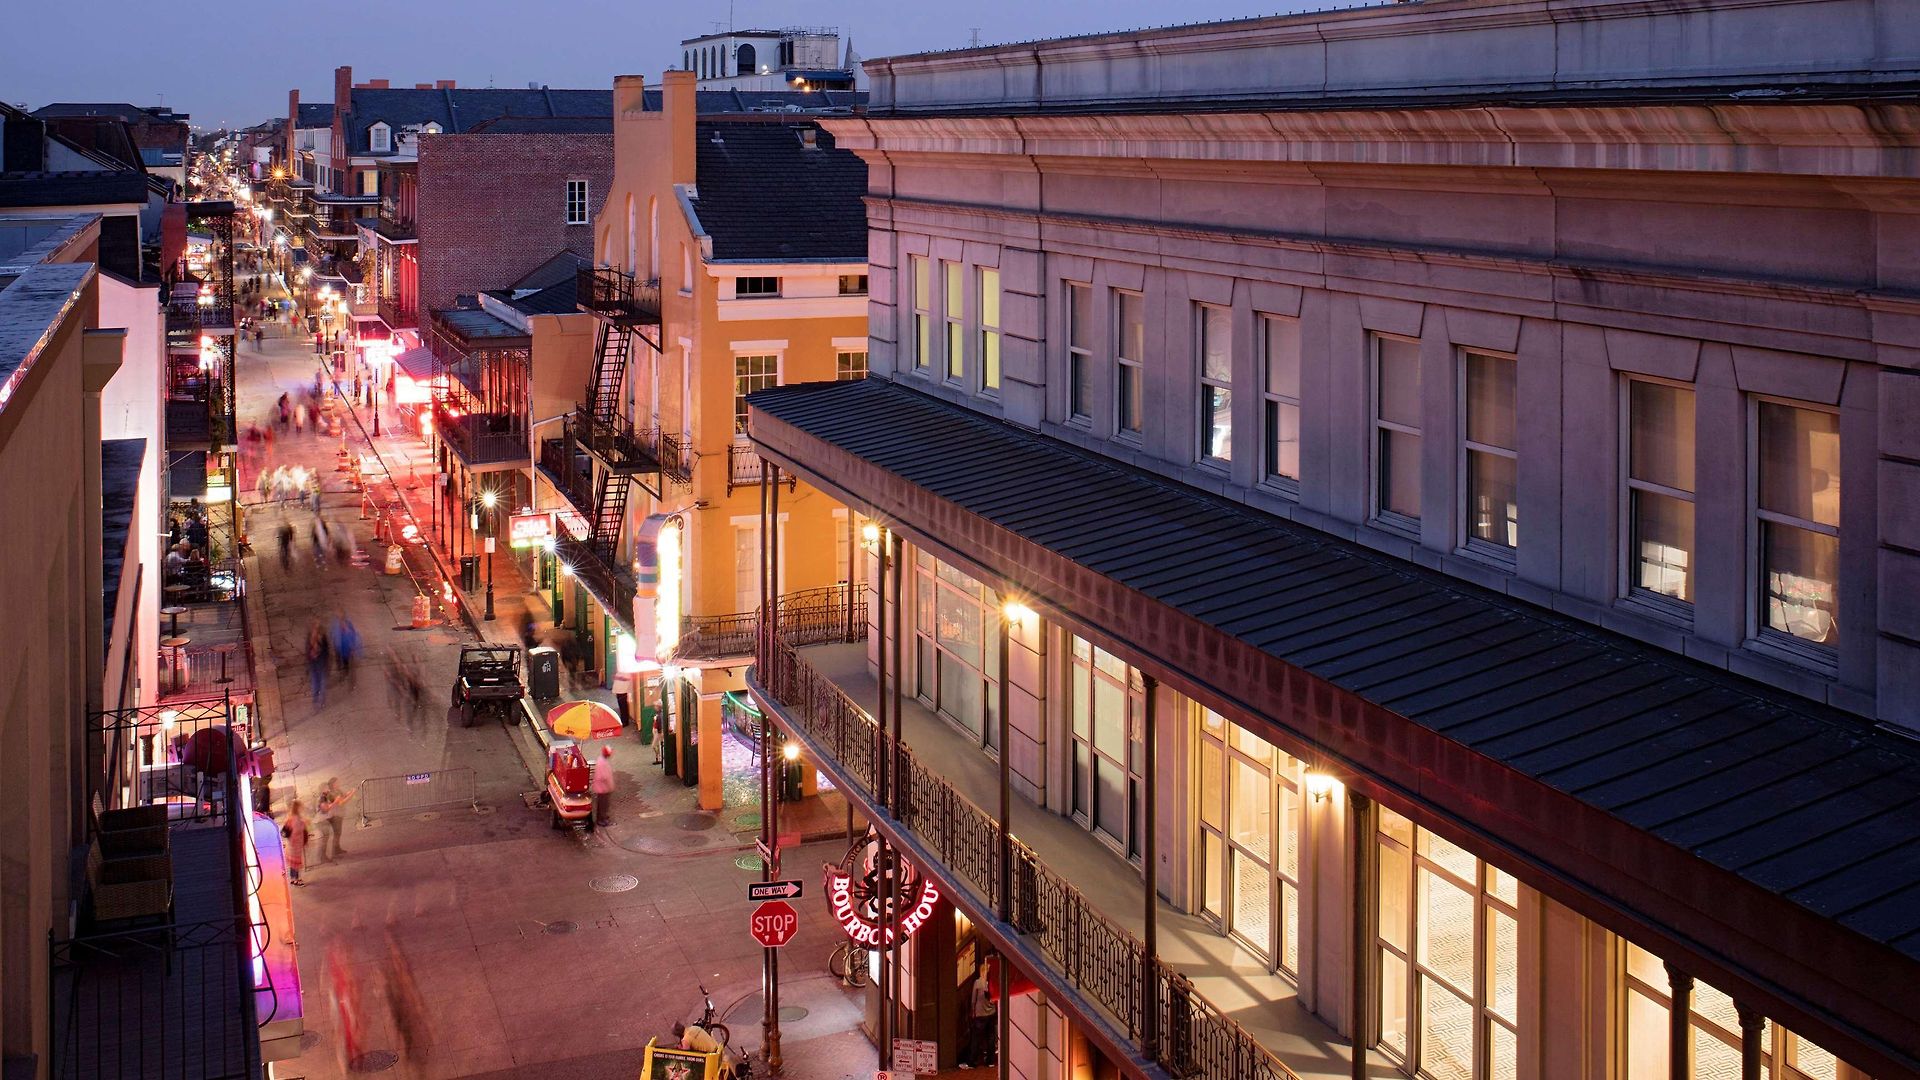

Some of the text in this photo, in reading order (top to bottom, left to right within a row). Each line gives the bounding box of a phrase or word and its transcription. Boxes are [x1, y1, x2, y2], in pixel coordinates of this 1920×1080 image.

[754, 886, 787, 896] ONE WAY
[754, 914, 794, 933] STOP
